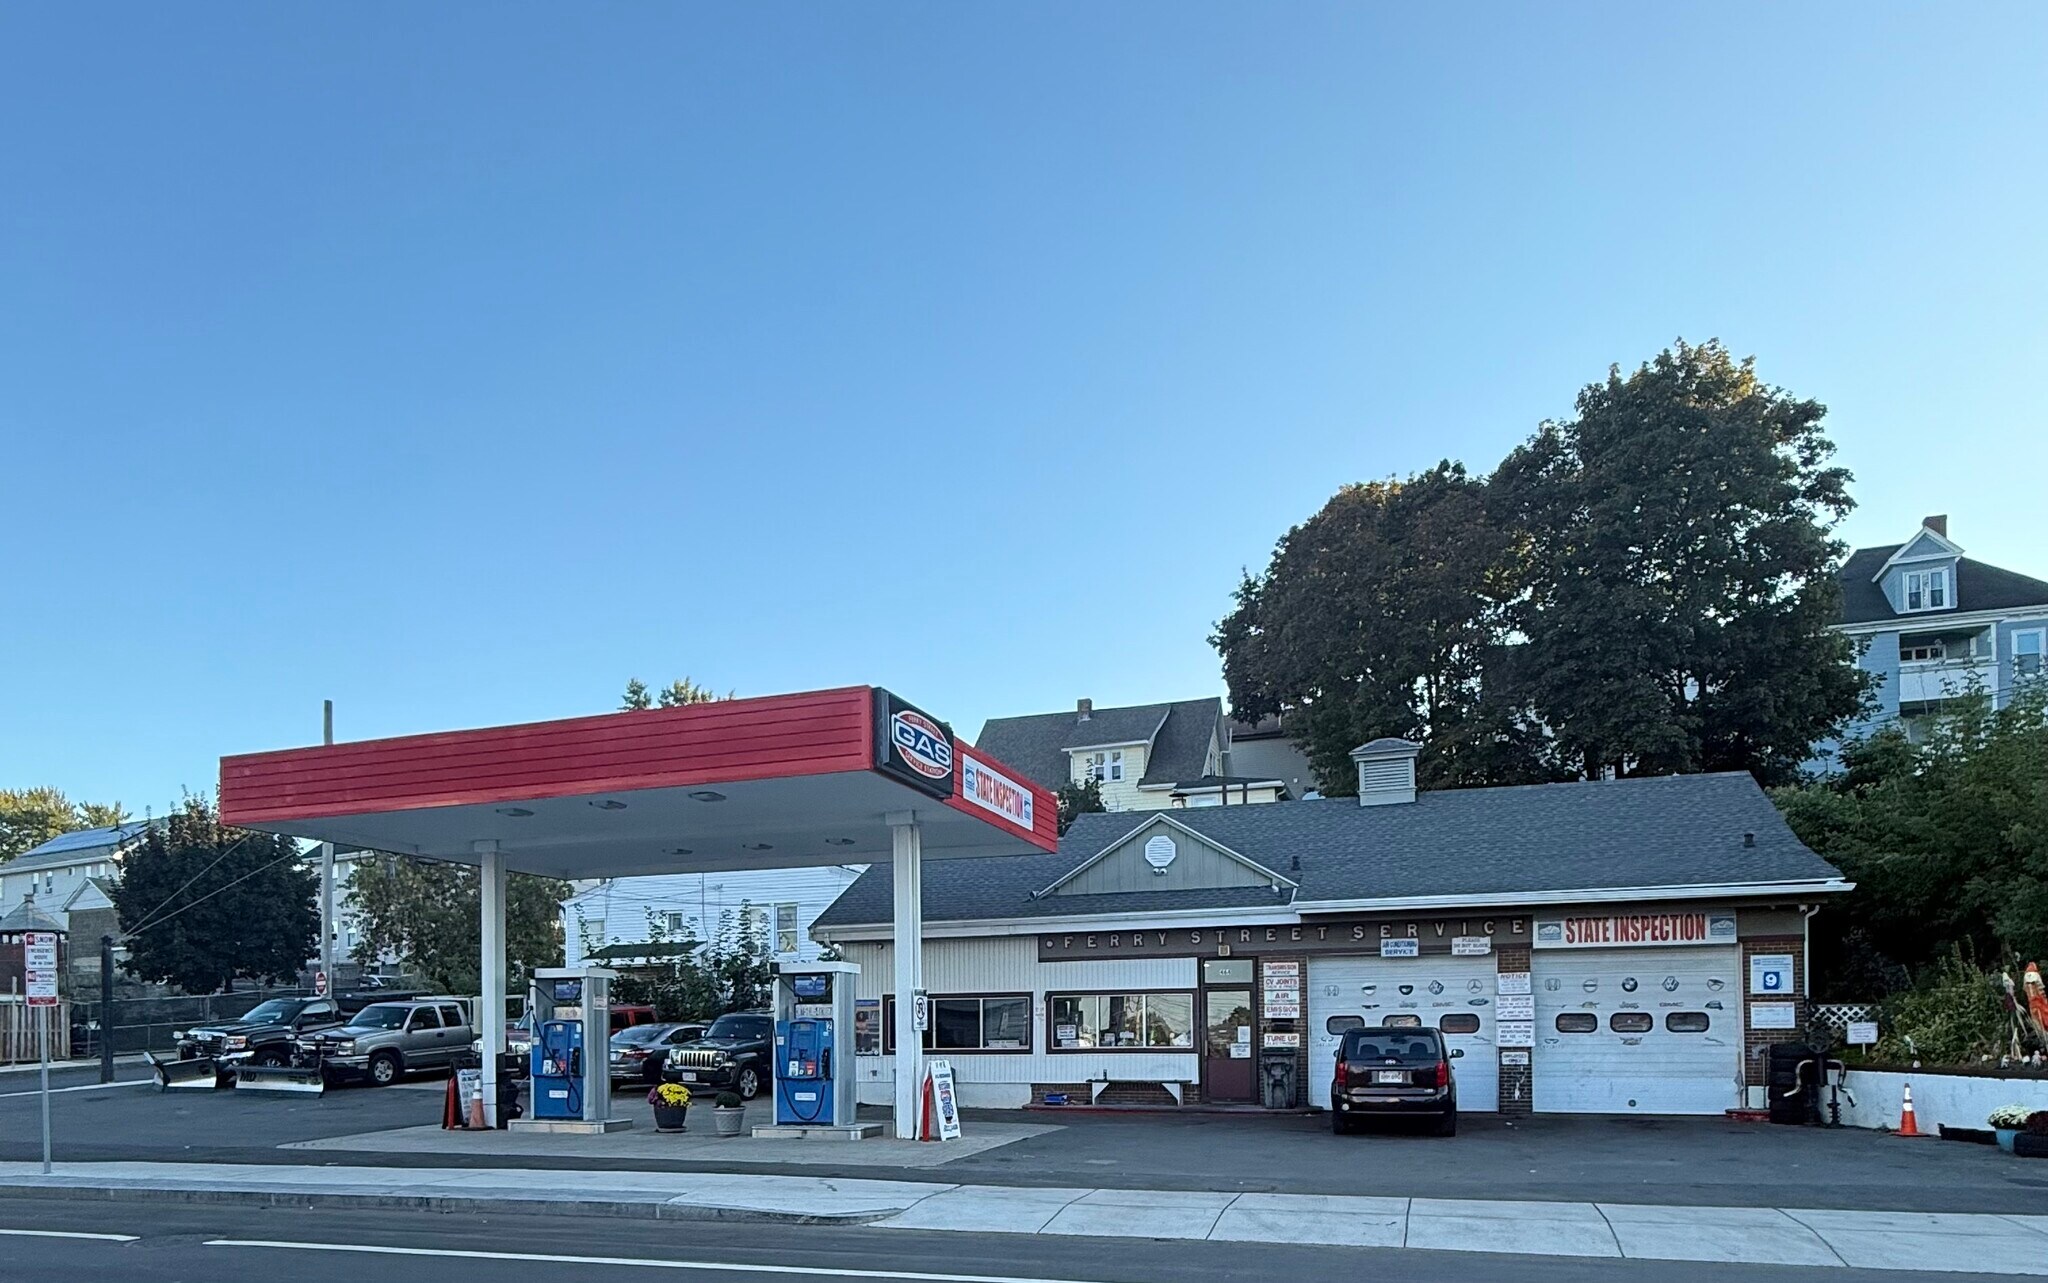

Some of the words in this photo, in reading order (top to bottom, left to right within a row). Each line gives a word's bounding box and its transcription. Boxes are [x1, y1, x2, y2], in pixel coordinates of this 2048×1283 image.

[895, 721, 950, 767] GAS
[976, 768, 993, 804] STATE
[993, 778, 1024, 819] INSPECTION
[1064, 932, 1167, 949] FERRY
[1191, 927, 1327, 944] STREET
[1352, 919, 1524, 939] SERVICE
[1565, 916, 1610, 943] STATE
[1613, 913, 1706, 942] INSPECTION
[1765, 973, 1777, 987] 9
